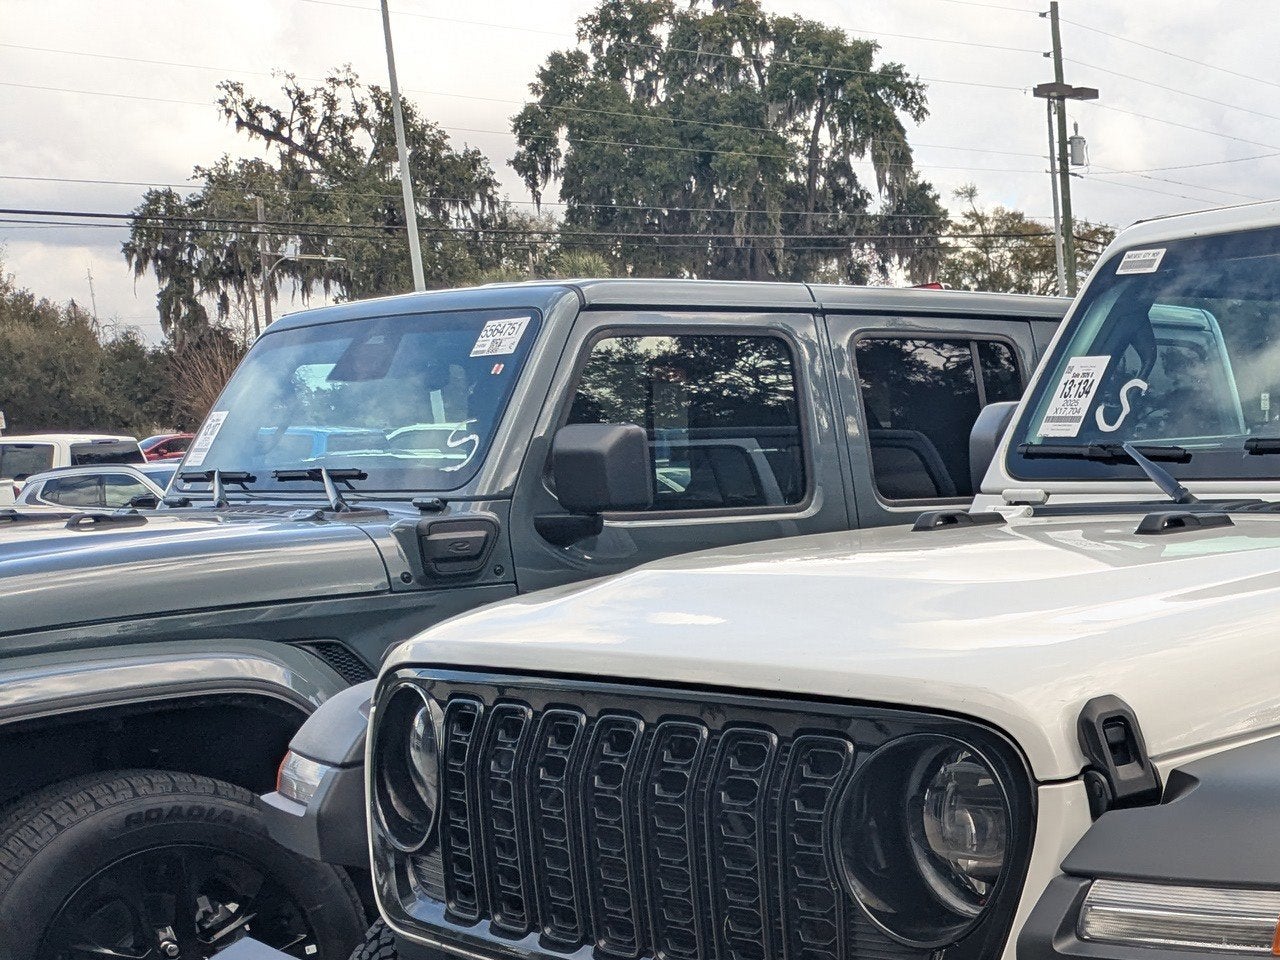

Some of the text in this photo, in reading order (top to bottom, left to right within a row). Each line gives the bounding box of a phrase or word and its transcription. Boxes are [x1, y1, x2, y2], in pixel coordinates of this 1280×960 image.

[480, 321, 523, 339] 5564751
[1059, 379, 1095, 399] 13:134
[1062, 399, 1080, 407] 2025
